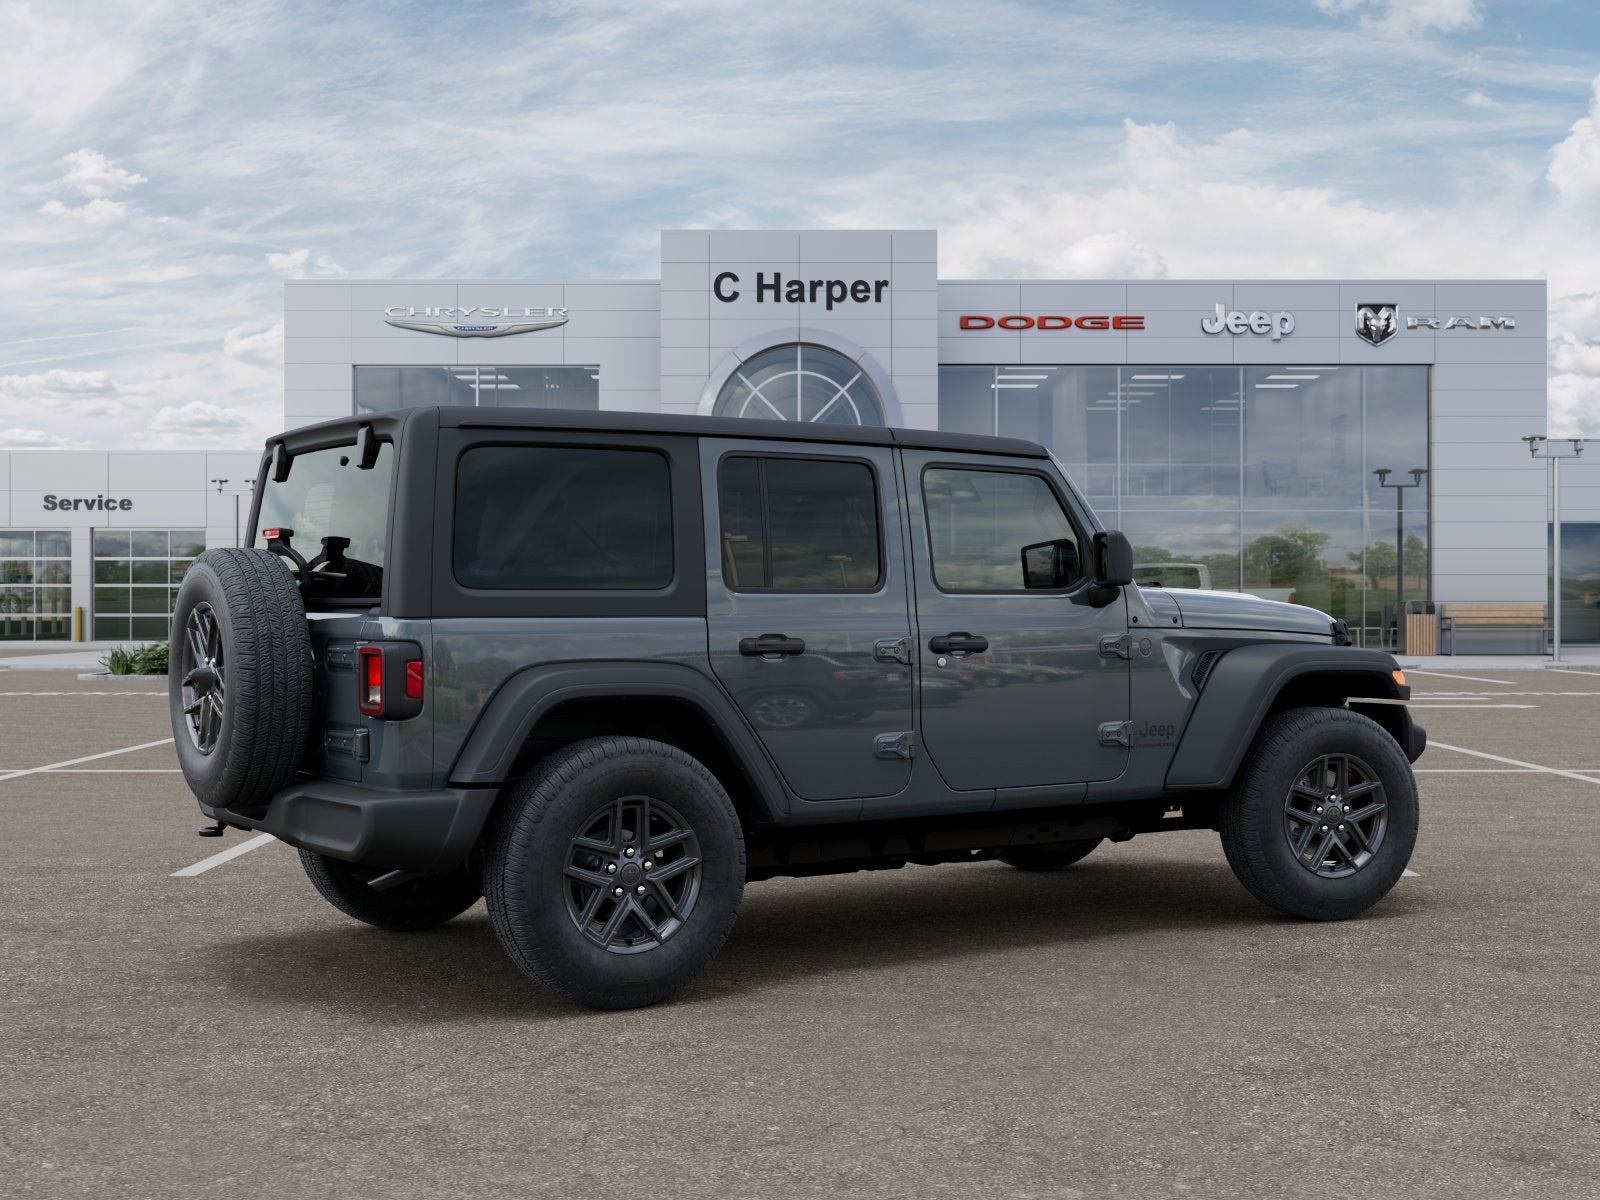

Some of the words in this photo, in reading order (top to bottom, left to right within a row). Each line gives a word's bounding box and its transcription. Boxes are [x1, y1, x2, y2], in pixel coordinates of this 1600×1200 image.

[713, 271, 740, 303] C
[756, 271, 890, 311] Harper
[384, 306, 569, 317] CHRYSLER
[959, 315, 1146, 330] DODGE
[1201, 302, 1296, 342] Jeep
[1406, 316, 1515, 330] RAM
[43, 494, 133, 511] Service
[1138, 720, 1175, 739] Jeep
